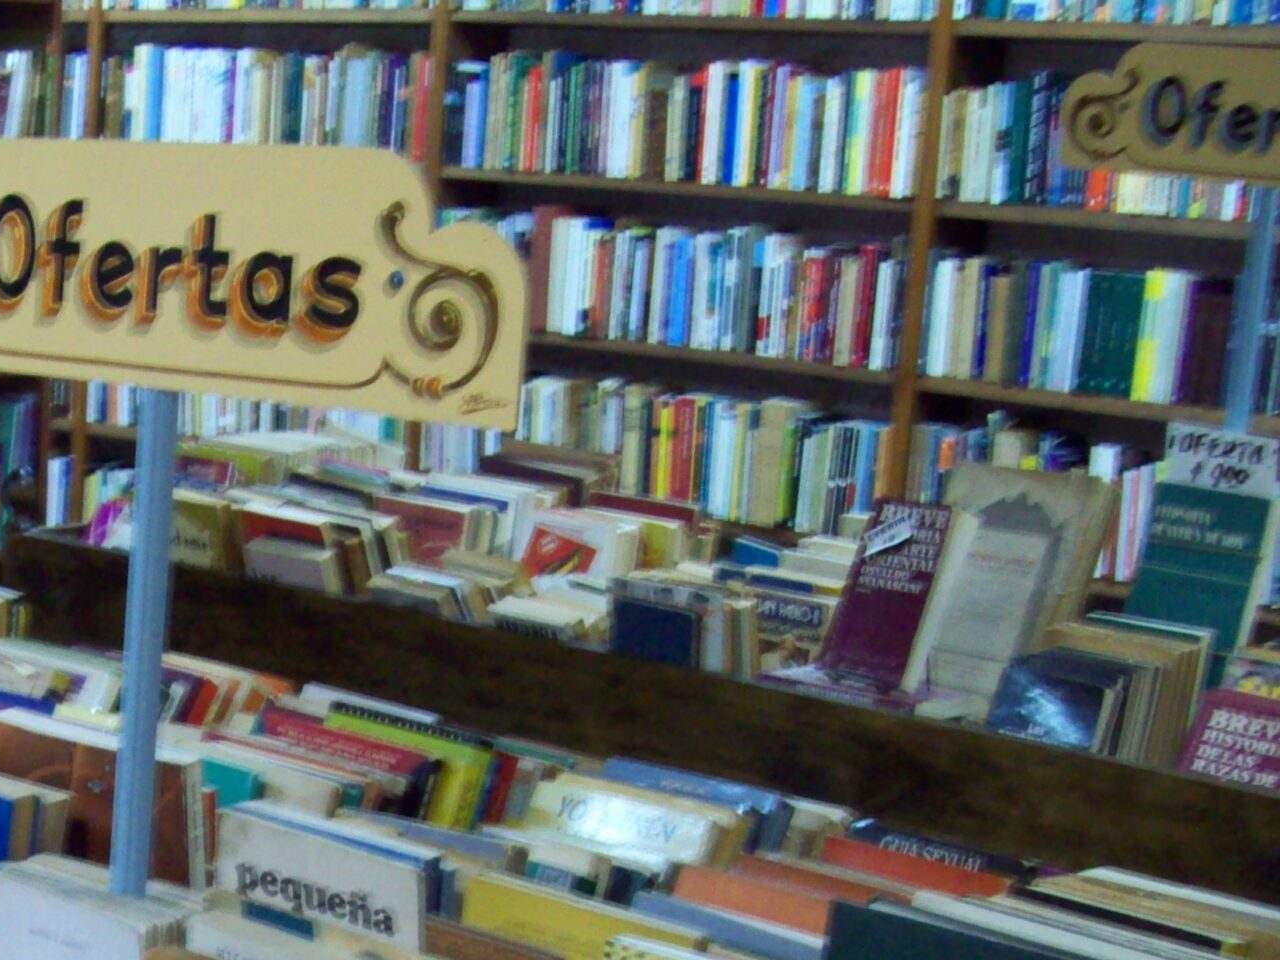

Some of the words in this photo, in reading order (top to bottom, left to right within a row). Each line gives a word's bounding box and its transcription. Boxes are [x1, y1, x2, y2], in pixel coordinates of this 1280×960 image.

[1208, 709, 1280, 741] BREV
[1197, 743, 1224, 760] DE
[1223, 751, 1258, 767] LAS
[1190, 758, 1252, 783] RAZAS
[1253, 772, 1279, 788] DE
[235, 859, 397, 937] pequeña
